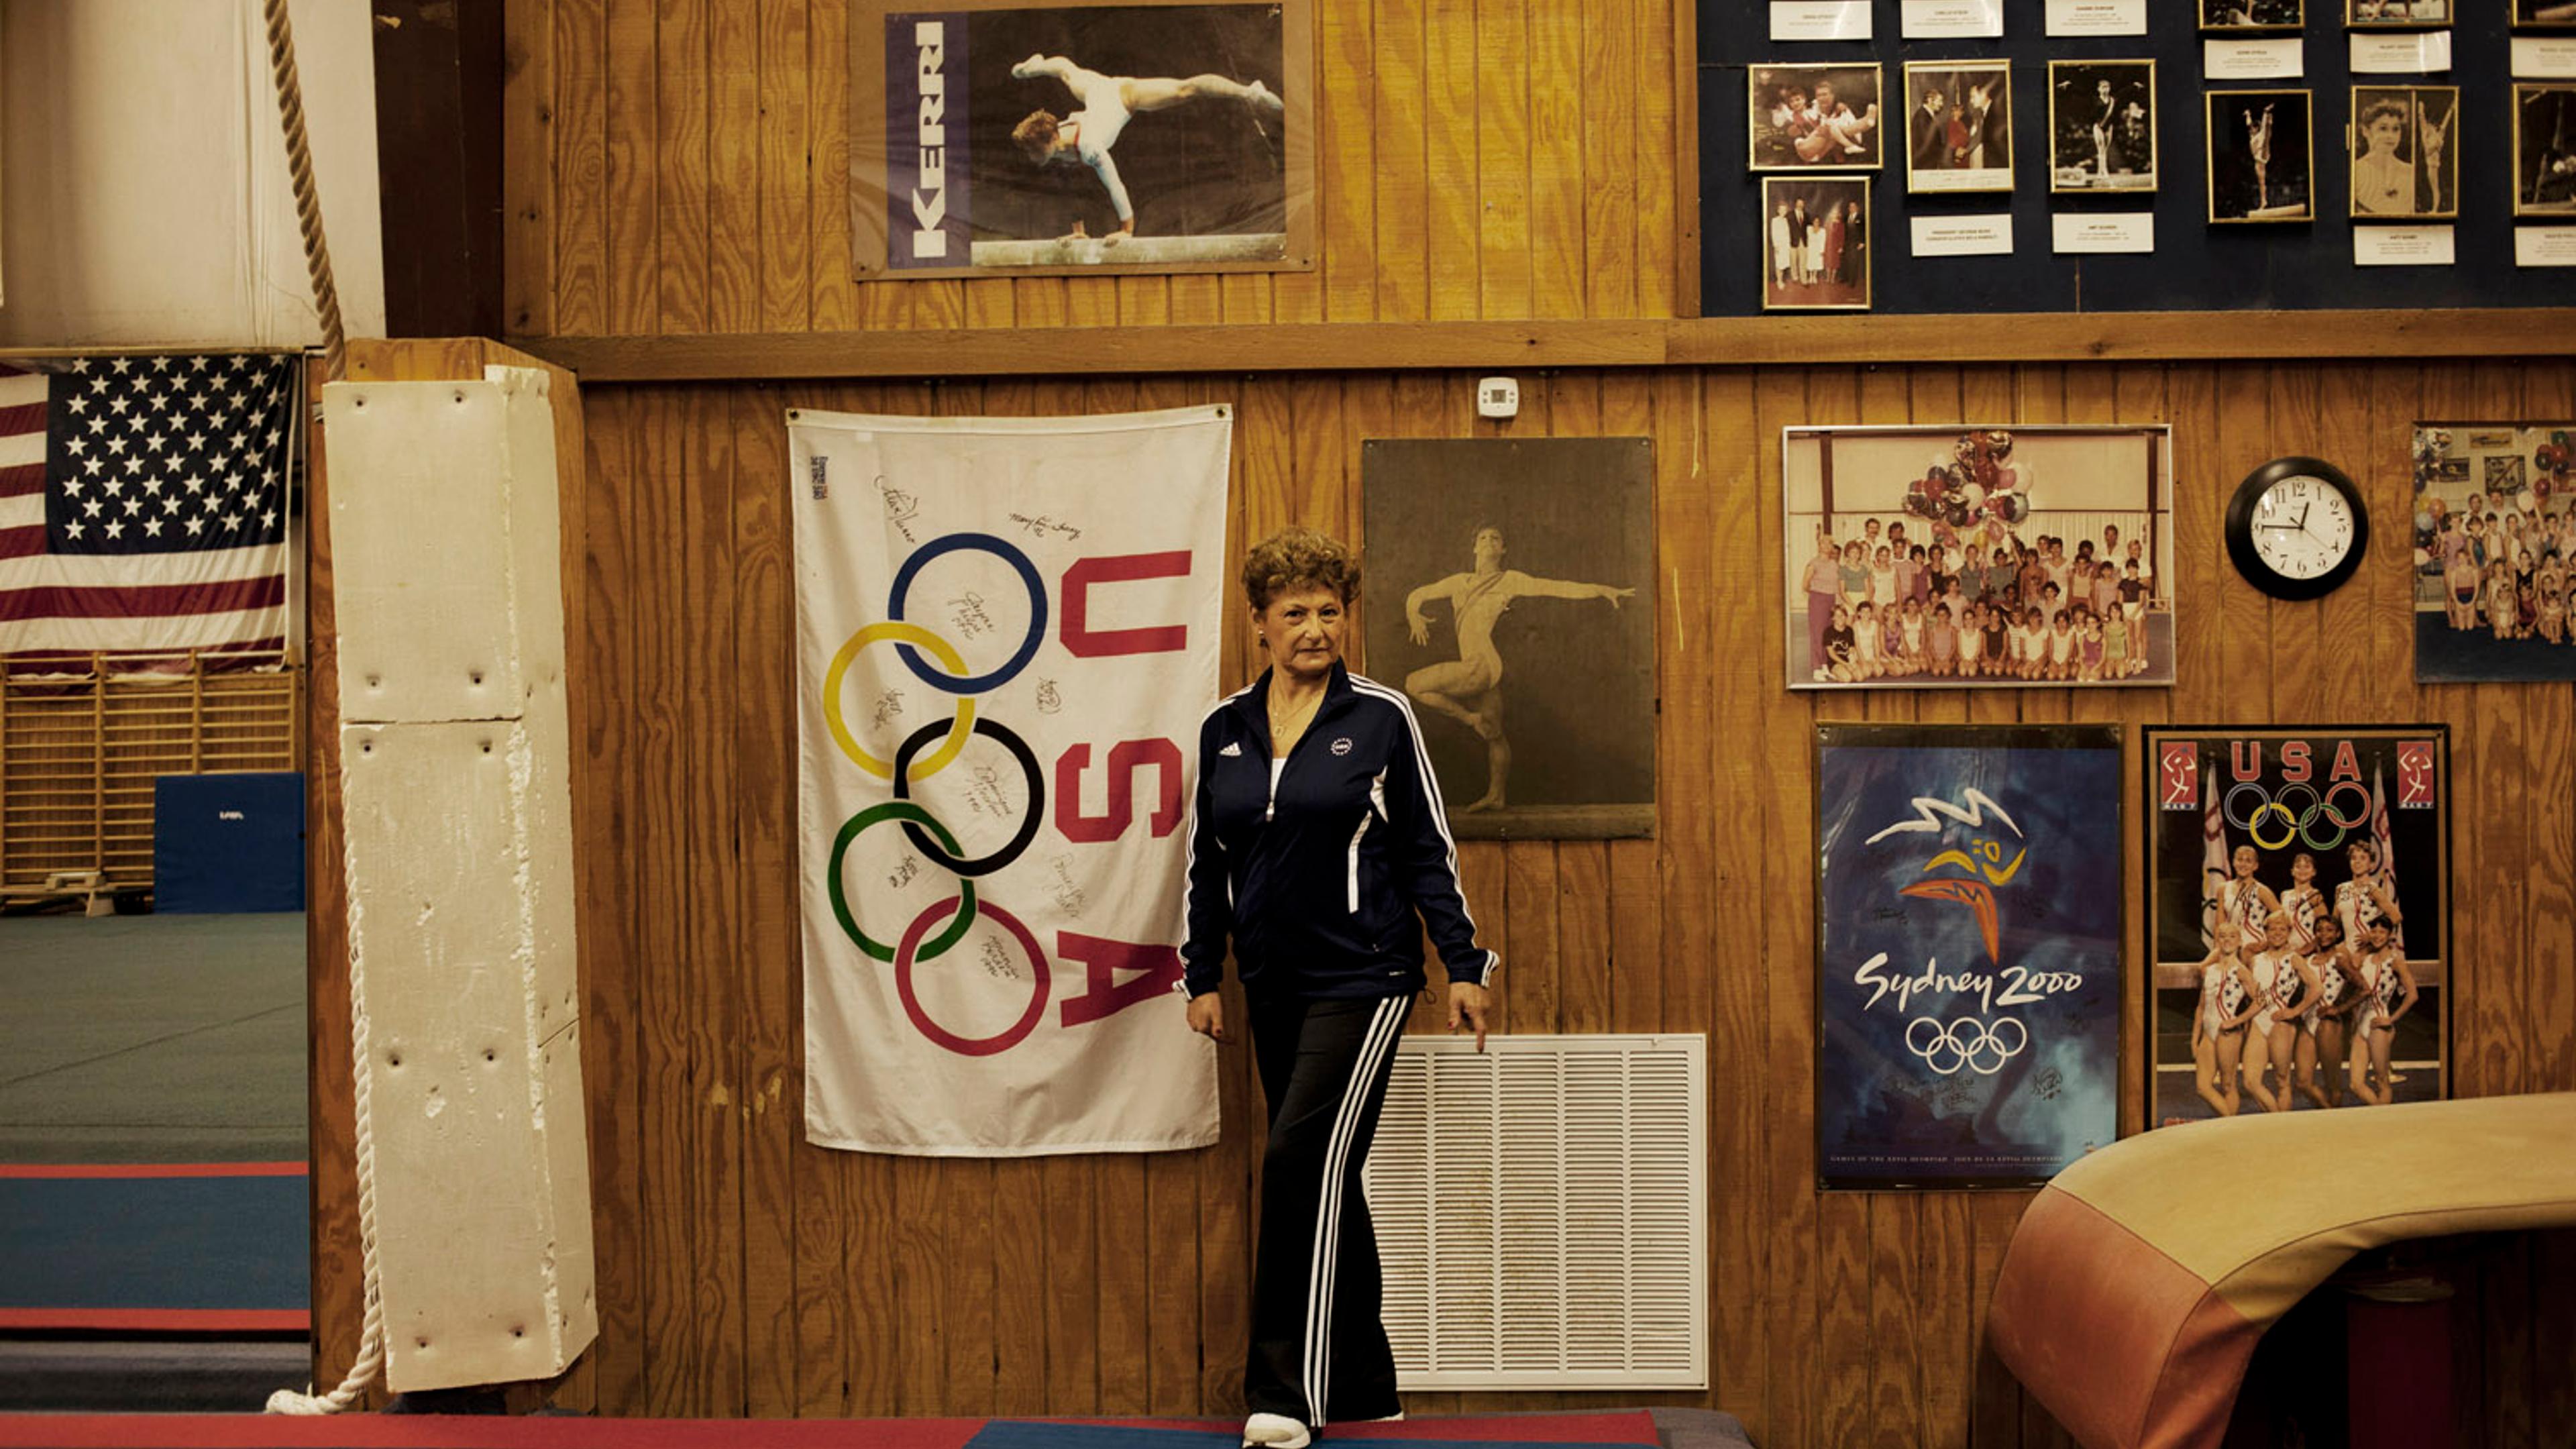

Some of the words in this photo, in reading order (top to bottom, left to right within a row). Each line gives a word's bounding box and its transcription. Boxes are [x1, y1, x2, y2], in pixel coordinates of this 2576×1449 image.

[913, 21, 946, 258] KERRI
[2275, 488, 2286, 503] 11
[2292, 482, 2306, 497] 12
[2330, 499, 2340, 515] 2
[2337, 518, 2347, 533] 3
[2262, 541, 2272, 555] 8
[2330, 540, 2340, 553] 4
[2279, 554, 2288, 570] 7
[2297, 559, 2307, 574] 6
[2316, 552, 2327, 568] 5
[2231, 741, 2362, 782] USA
[1055, 550, 1192, 1028] USA
[1854, 953, 1993, 1014] Sydney
[1995, 966, 2082, 1006] 2000
